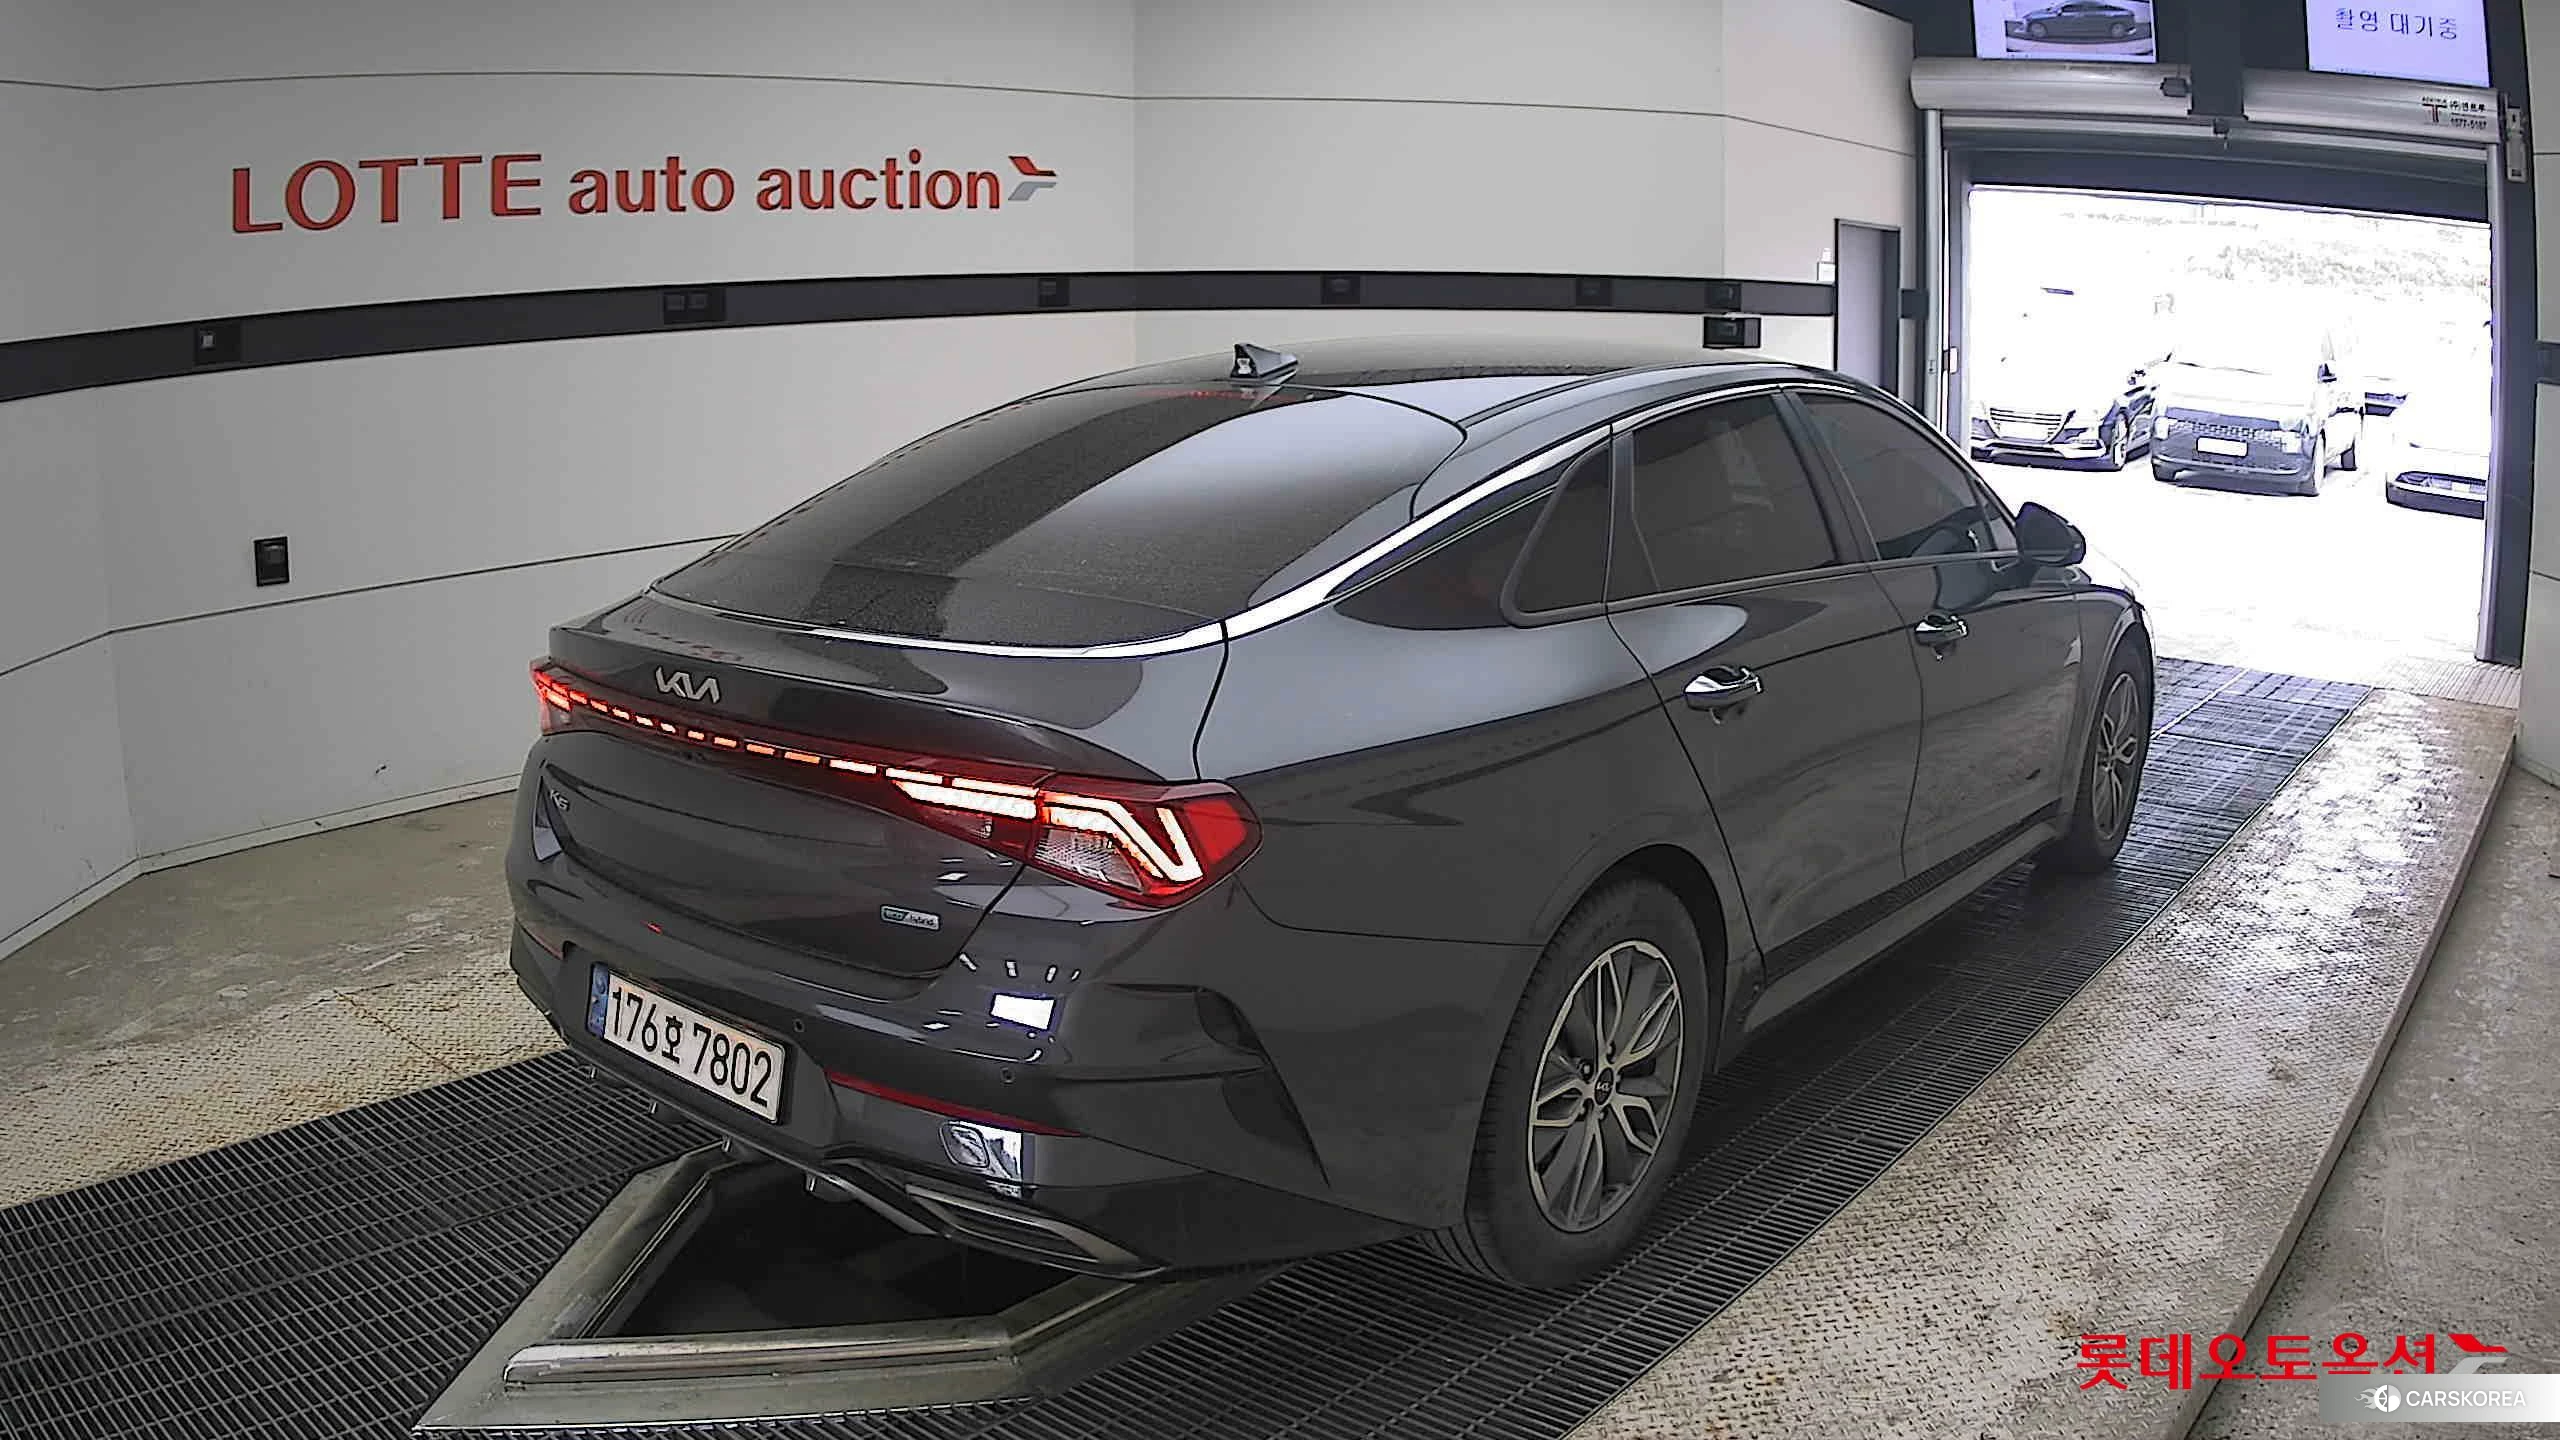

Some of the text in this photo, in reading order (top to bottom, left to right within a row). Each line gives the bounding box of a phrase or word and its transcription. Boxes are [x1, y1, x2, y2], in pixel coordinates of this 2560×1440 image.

[2335, 7, 2458, 40] 촬영 대기 중
[232, 148, 1001, 234] LOTTE auto auction
[655, 665, 721, 704] KIA
[692, 1021, 773, 1108] 7802
